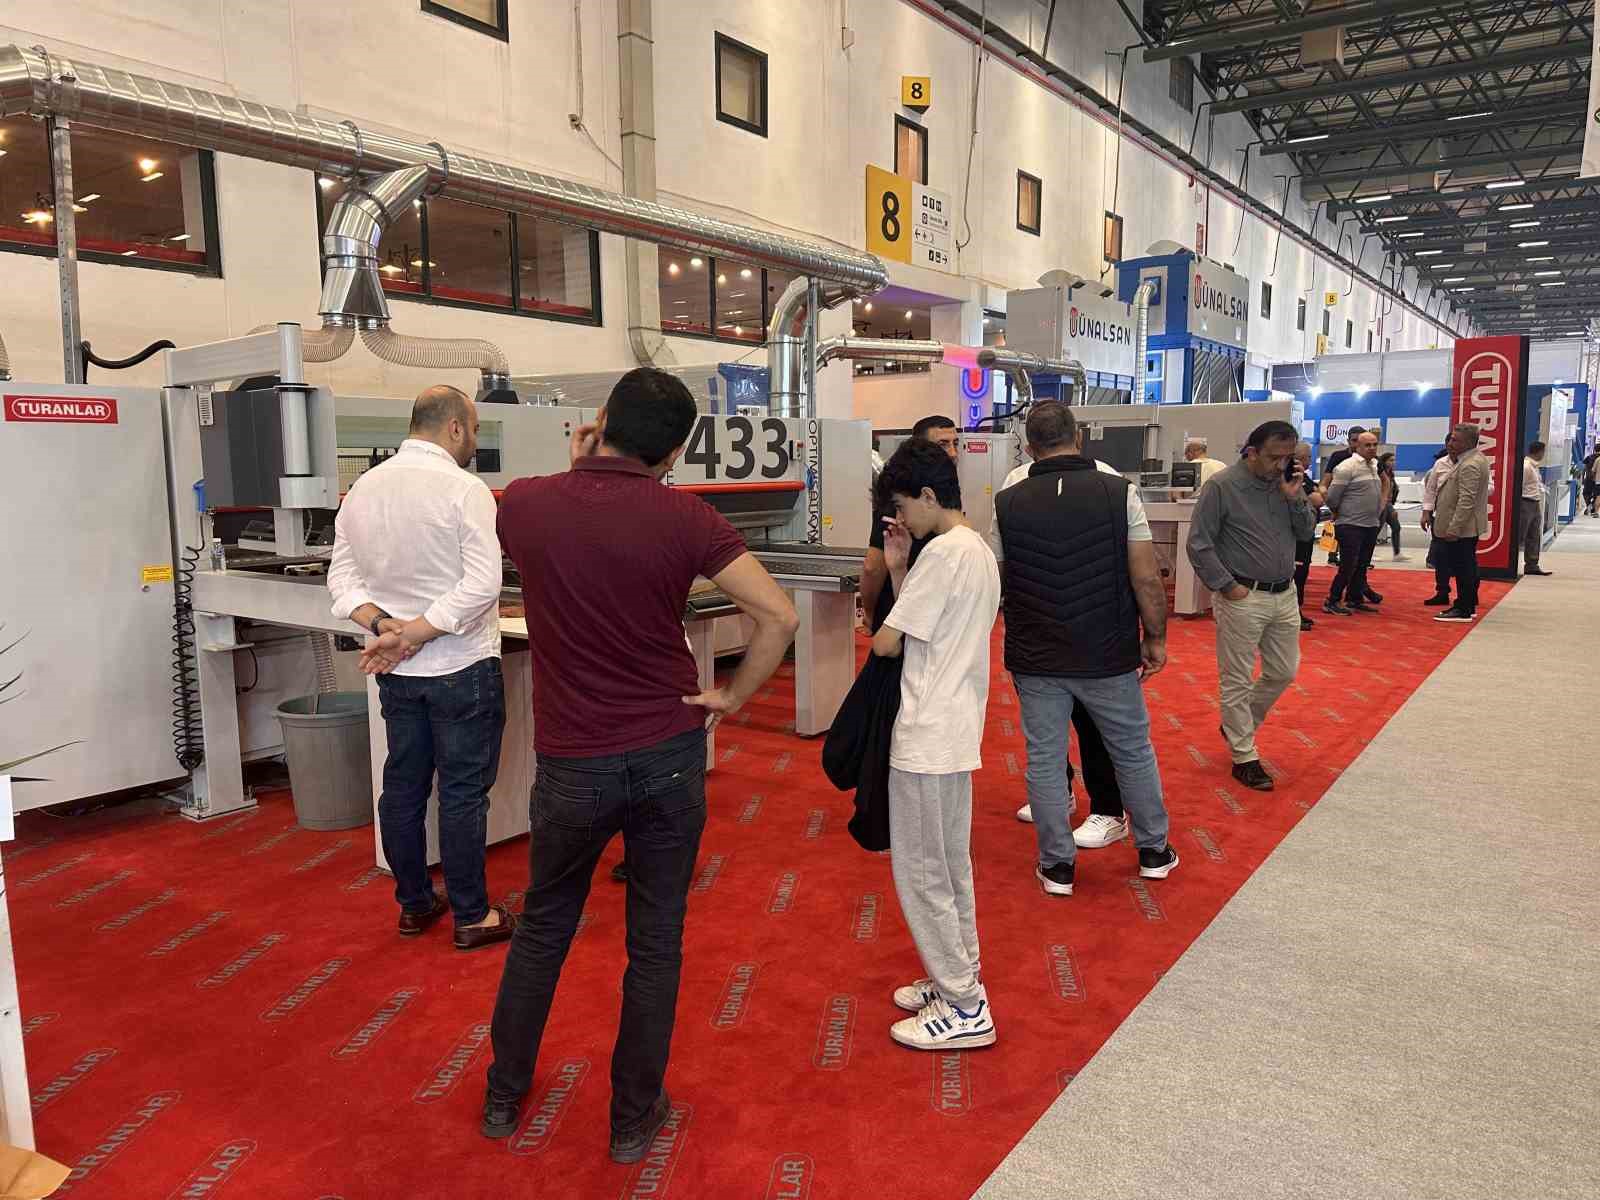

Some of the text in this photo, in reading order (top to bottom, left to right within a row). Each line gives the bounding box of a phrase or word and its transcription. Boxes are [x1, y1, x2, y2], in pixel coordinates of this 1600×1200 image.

[911, 82, 923, 99] 8
[881, 191, 900, 242] 8
[1078, 312, 1131, 345] ÜNALSAN
[17, 402, 106, 417] TURANLAR
[684, 416, 789, 479] 433
[1130, 878, 1161, 921] TURANLA
[338, 987, 418, 1055] TURANLAR
[716, 965, 755, 1026] TURANLAR
[821, 996, 850, 1065] TURANLAR
[420, 1024, 491, 1099] TURANLAR
[516, 1062, 585, 1149] TURANLAR
